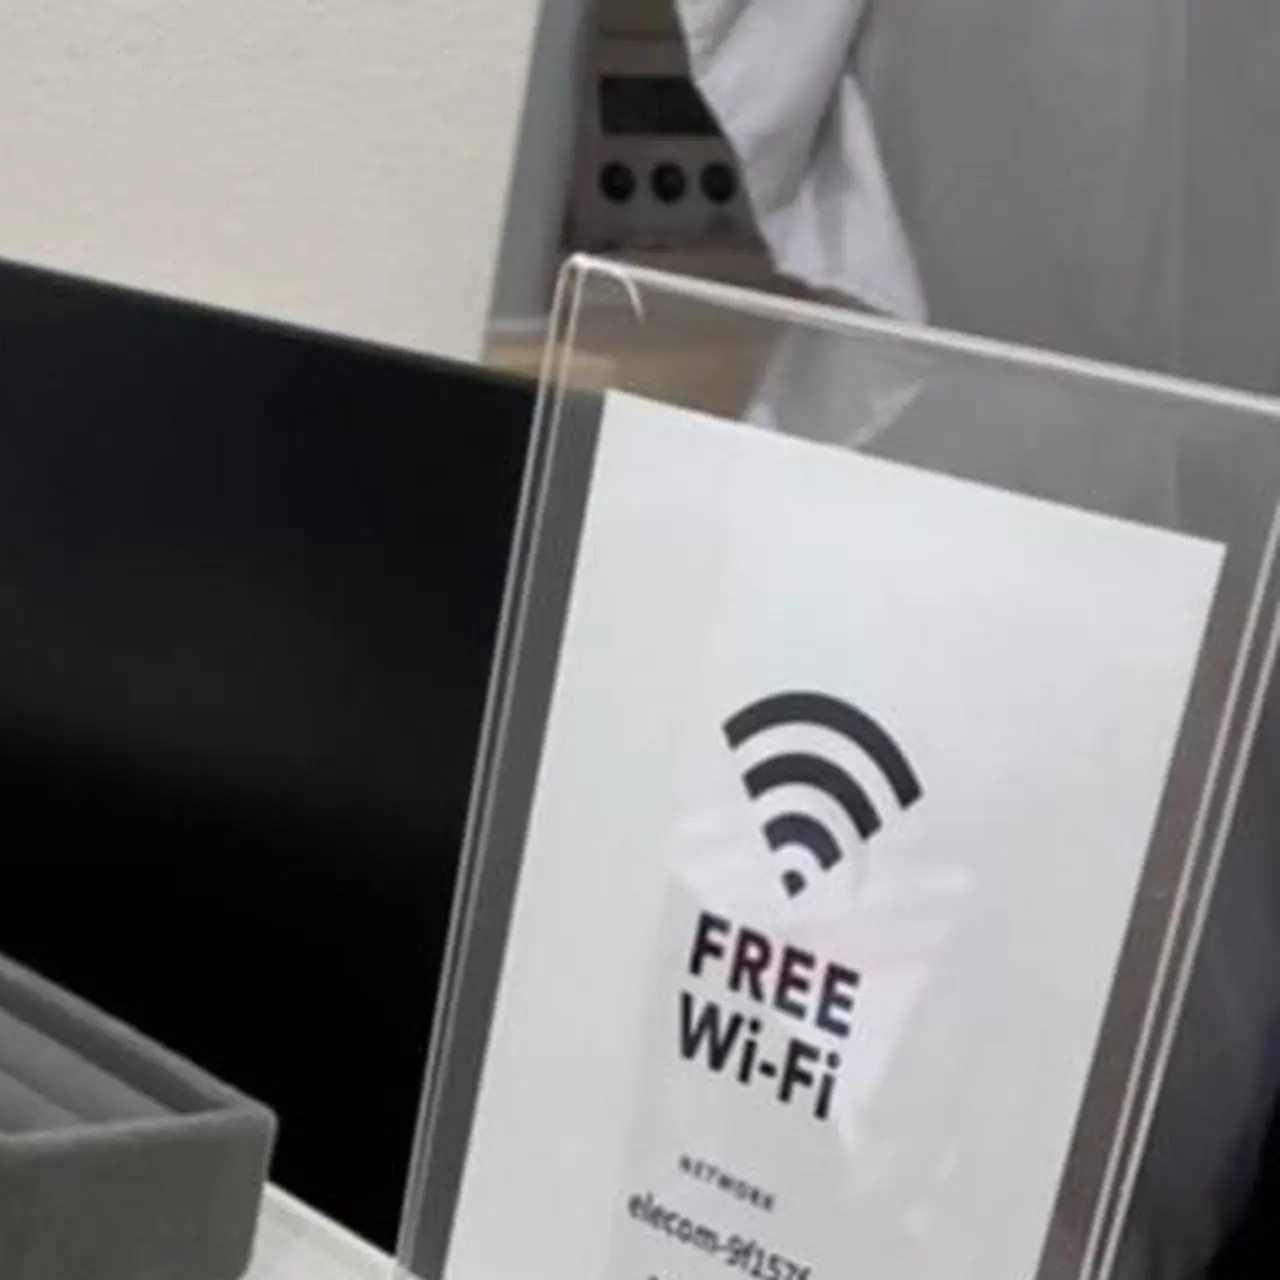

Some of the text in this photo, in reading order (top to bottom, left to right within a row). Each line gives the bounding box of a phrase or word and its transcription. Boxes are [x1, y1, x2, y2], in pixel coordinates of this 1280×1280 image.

[689, 909, 861, 1038] FREE
[679, 990, 841, 1122] Wi-Fi
[678, 1152, 776, 1214] NETWORK
